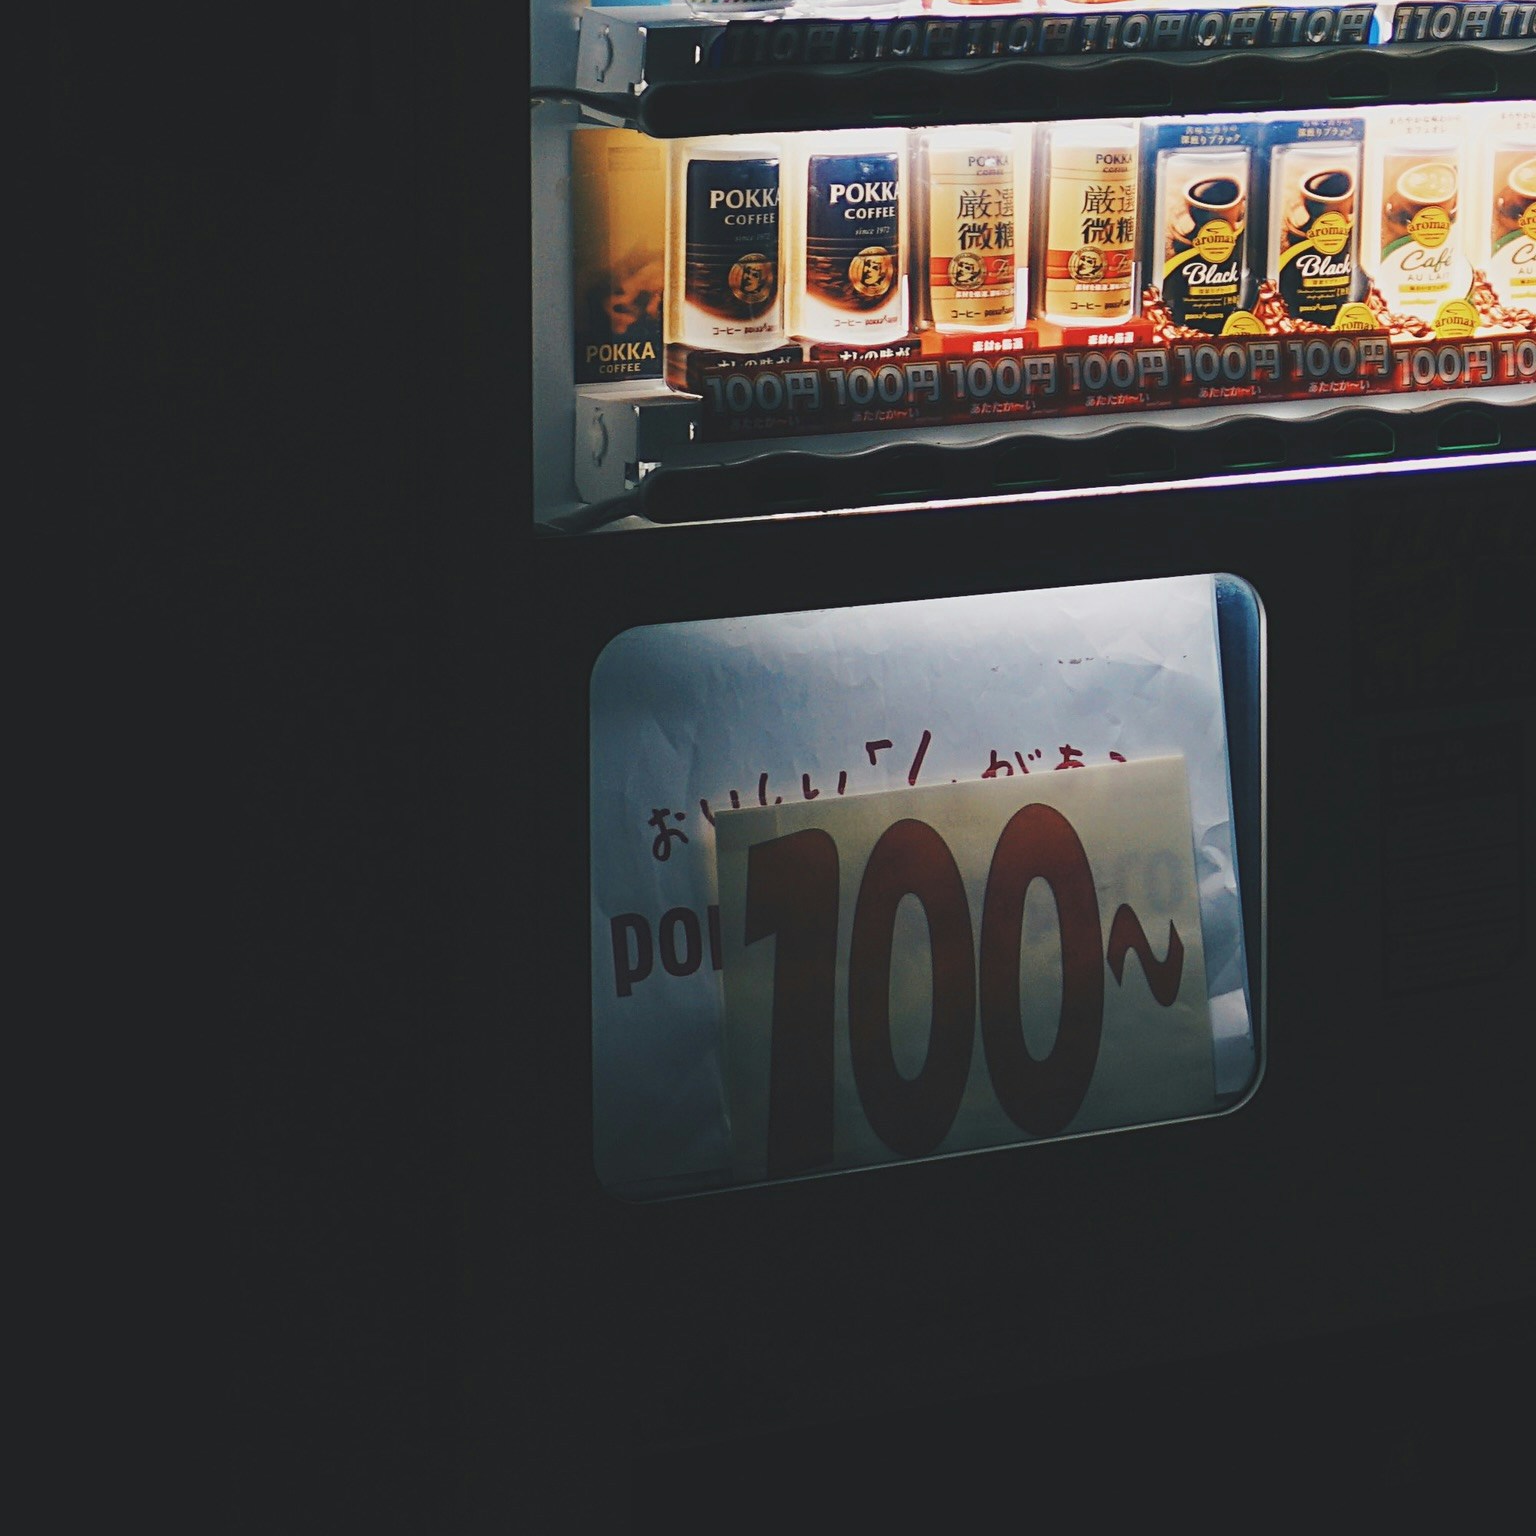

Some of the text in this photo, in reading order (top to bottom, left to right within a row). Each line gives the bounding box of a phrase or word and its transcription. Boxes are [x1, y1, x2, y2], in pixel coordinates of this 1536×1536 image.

[724, 213, 775, 225] COFFEE
[844, 207, 896, 219] COFFEE
[1182, 262, 1239, 285] Black
[1296, 254, 1352, 277] Black
[1435, 315, 1478, 329] aromax
[586, 342, 656, 363] POKKA
[1289, 339, 1391, 379] 100円
[599, 362, 641, 374] COFFEE
[1065, 351, 1170, 394] 100円
[1177, 345, 1281, 386] 100円
[827, 366, 940, 407] 100円
[949, 358, 1056, 399] 100円
[706, 372, 821, 413] 100円
